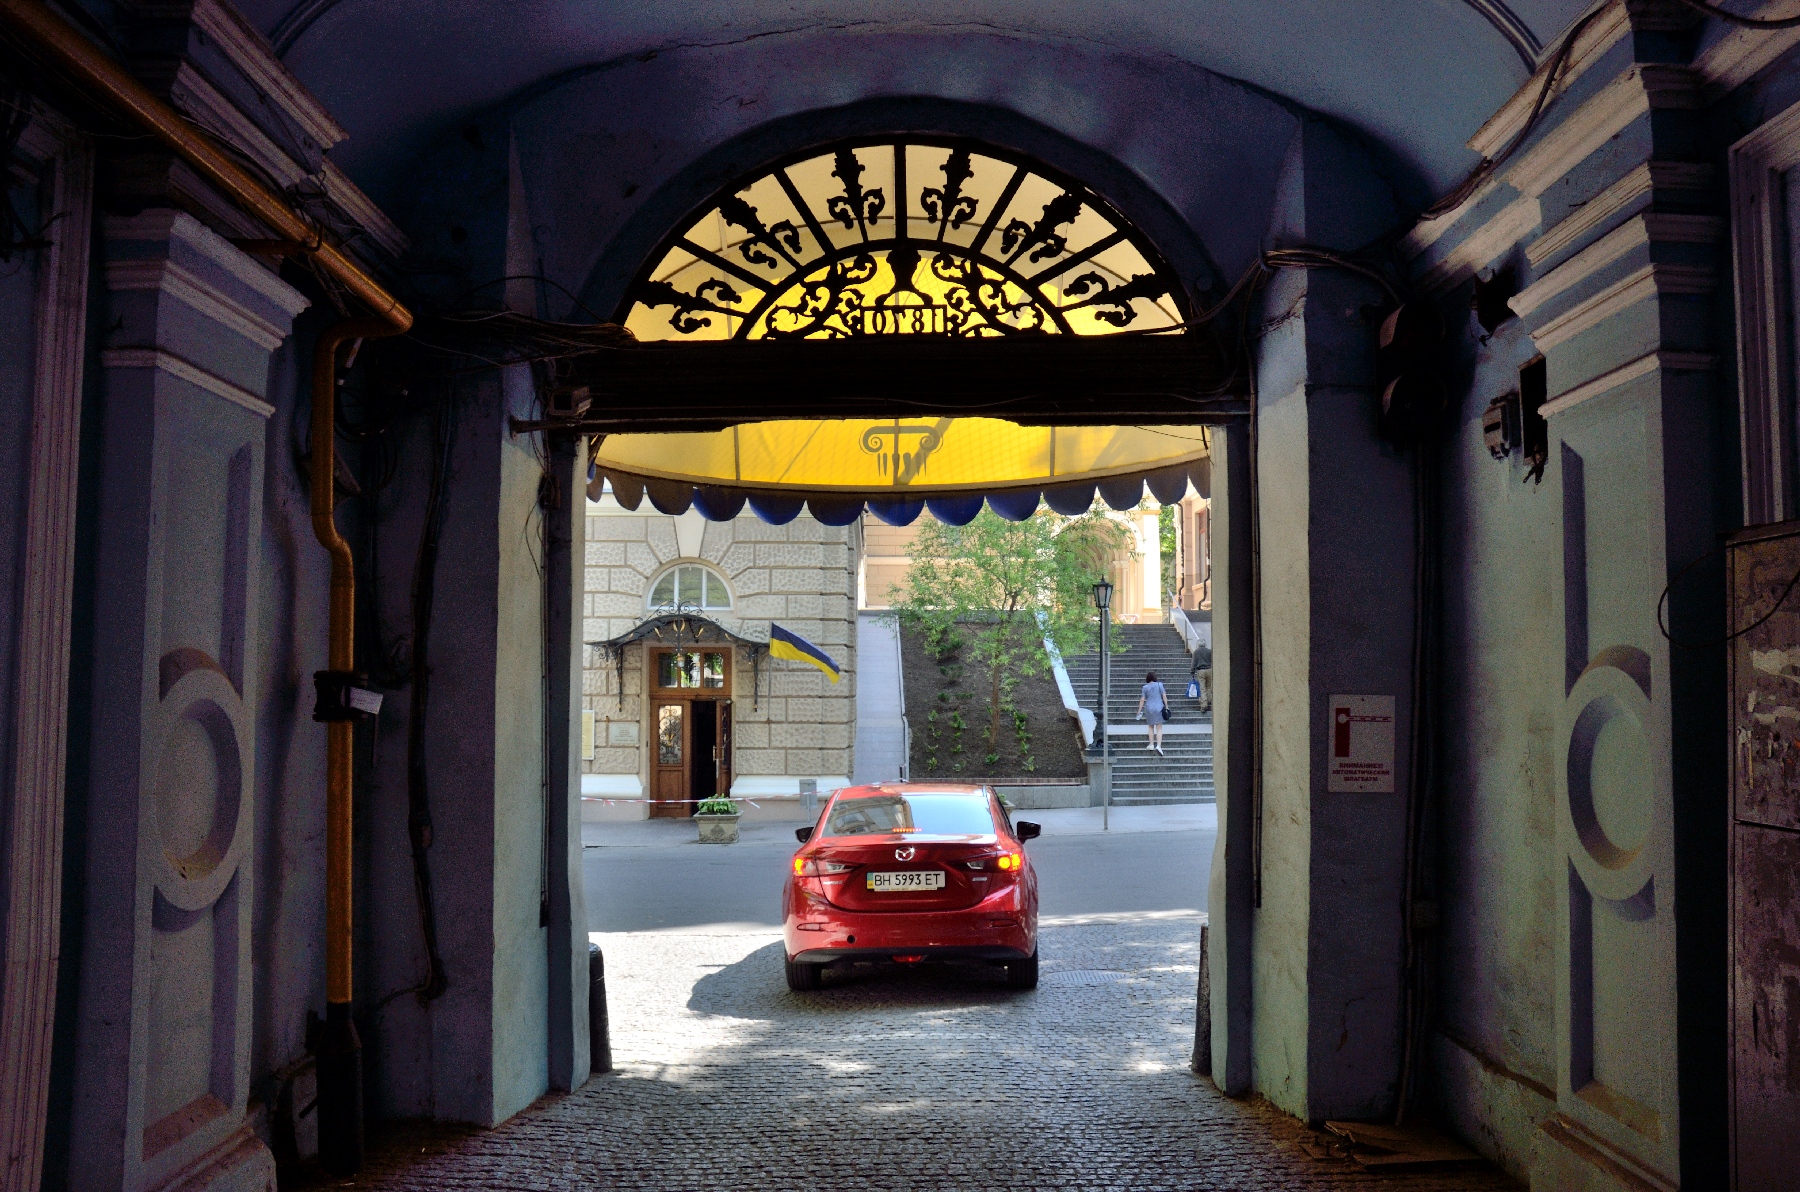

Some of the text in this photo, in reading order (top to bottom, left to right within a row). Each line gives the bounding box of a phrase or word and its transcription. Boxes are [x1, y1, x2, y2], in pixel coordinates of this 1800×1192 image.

[874, 873, 941, 886] BH 5993 ET
